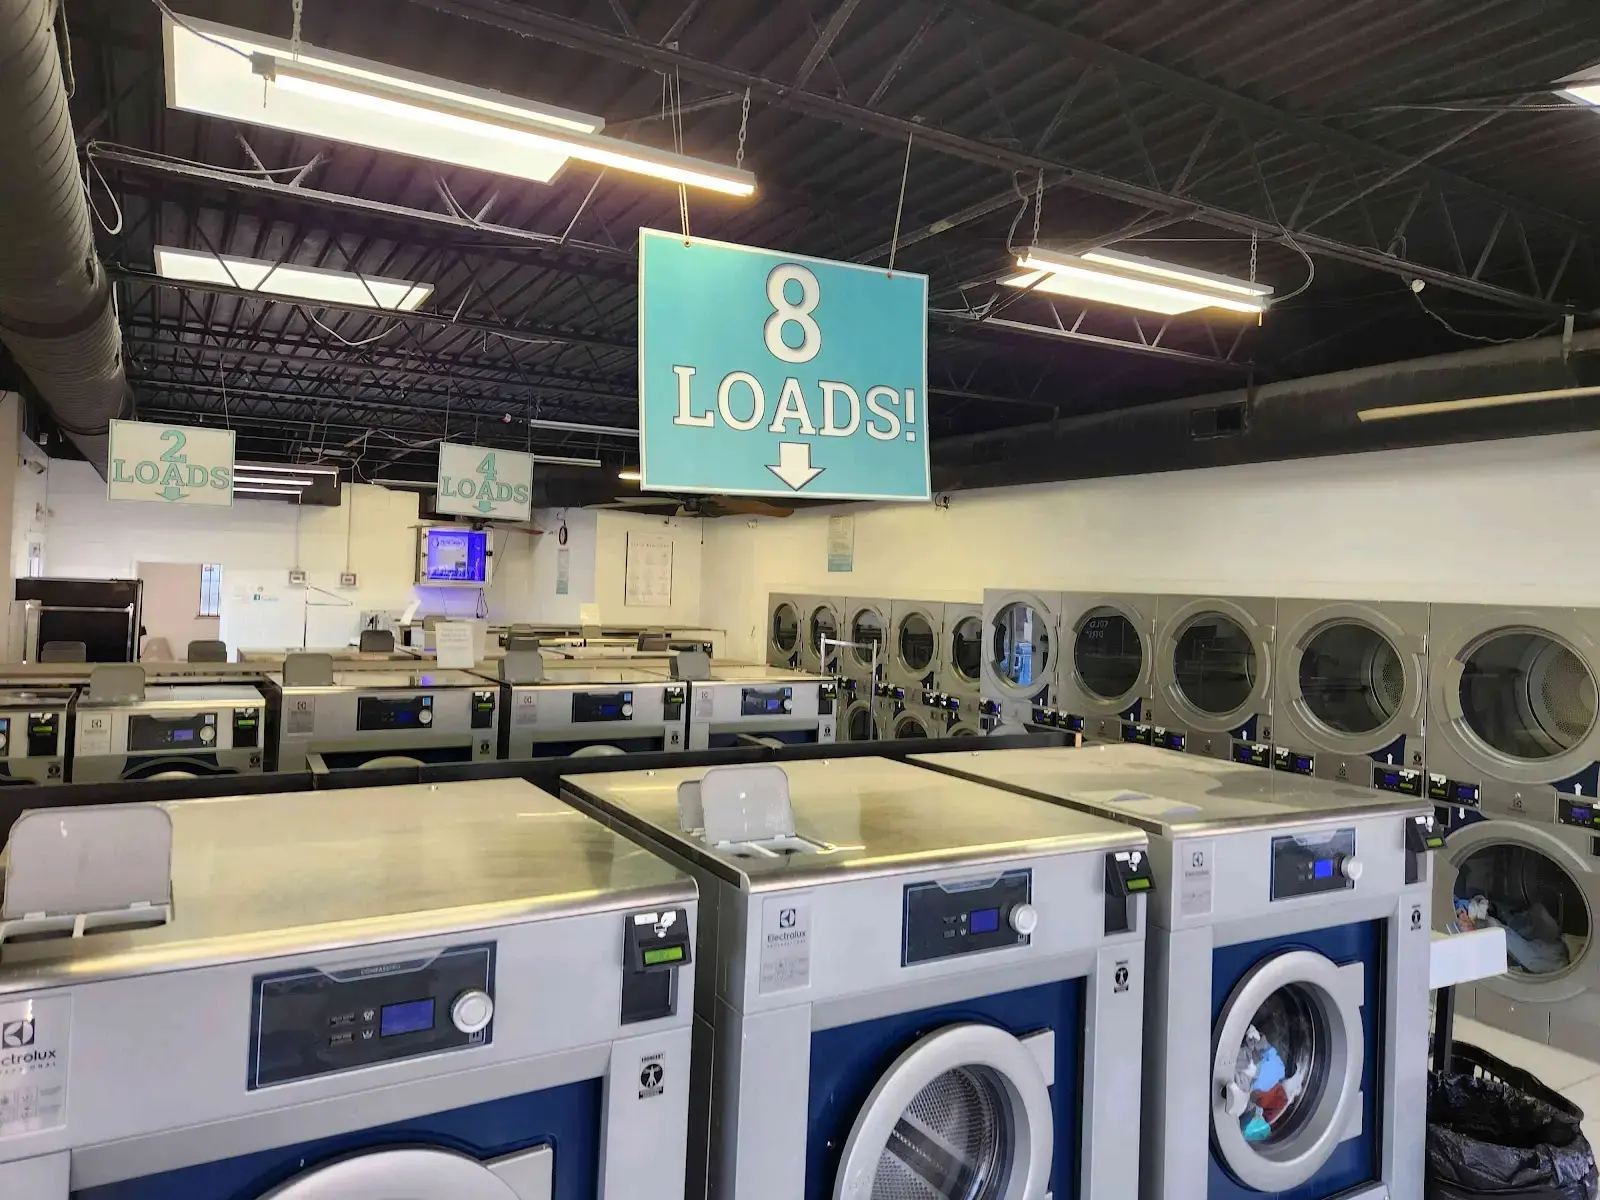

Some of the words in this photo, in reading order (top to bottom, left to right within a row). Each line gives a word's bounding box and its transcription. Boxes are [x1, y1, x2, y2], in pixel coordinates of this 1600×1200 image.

[762, 262, 823, 364] 8
[671, 365, 918, 443] LOADS!
[160, 429, 187, 463] 2
[113, 458, 230, 490] LOADS
[475, 452, 498, 481] 4
[441, 475, 529, 505] LOADS
[767, 930, 806, 943] Electrolux
